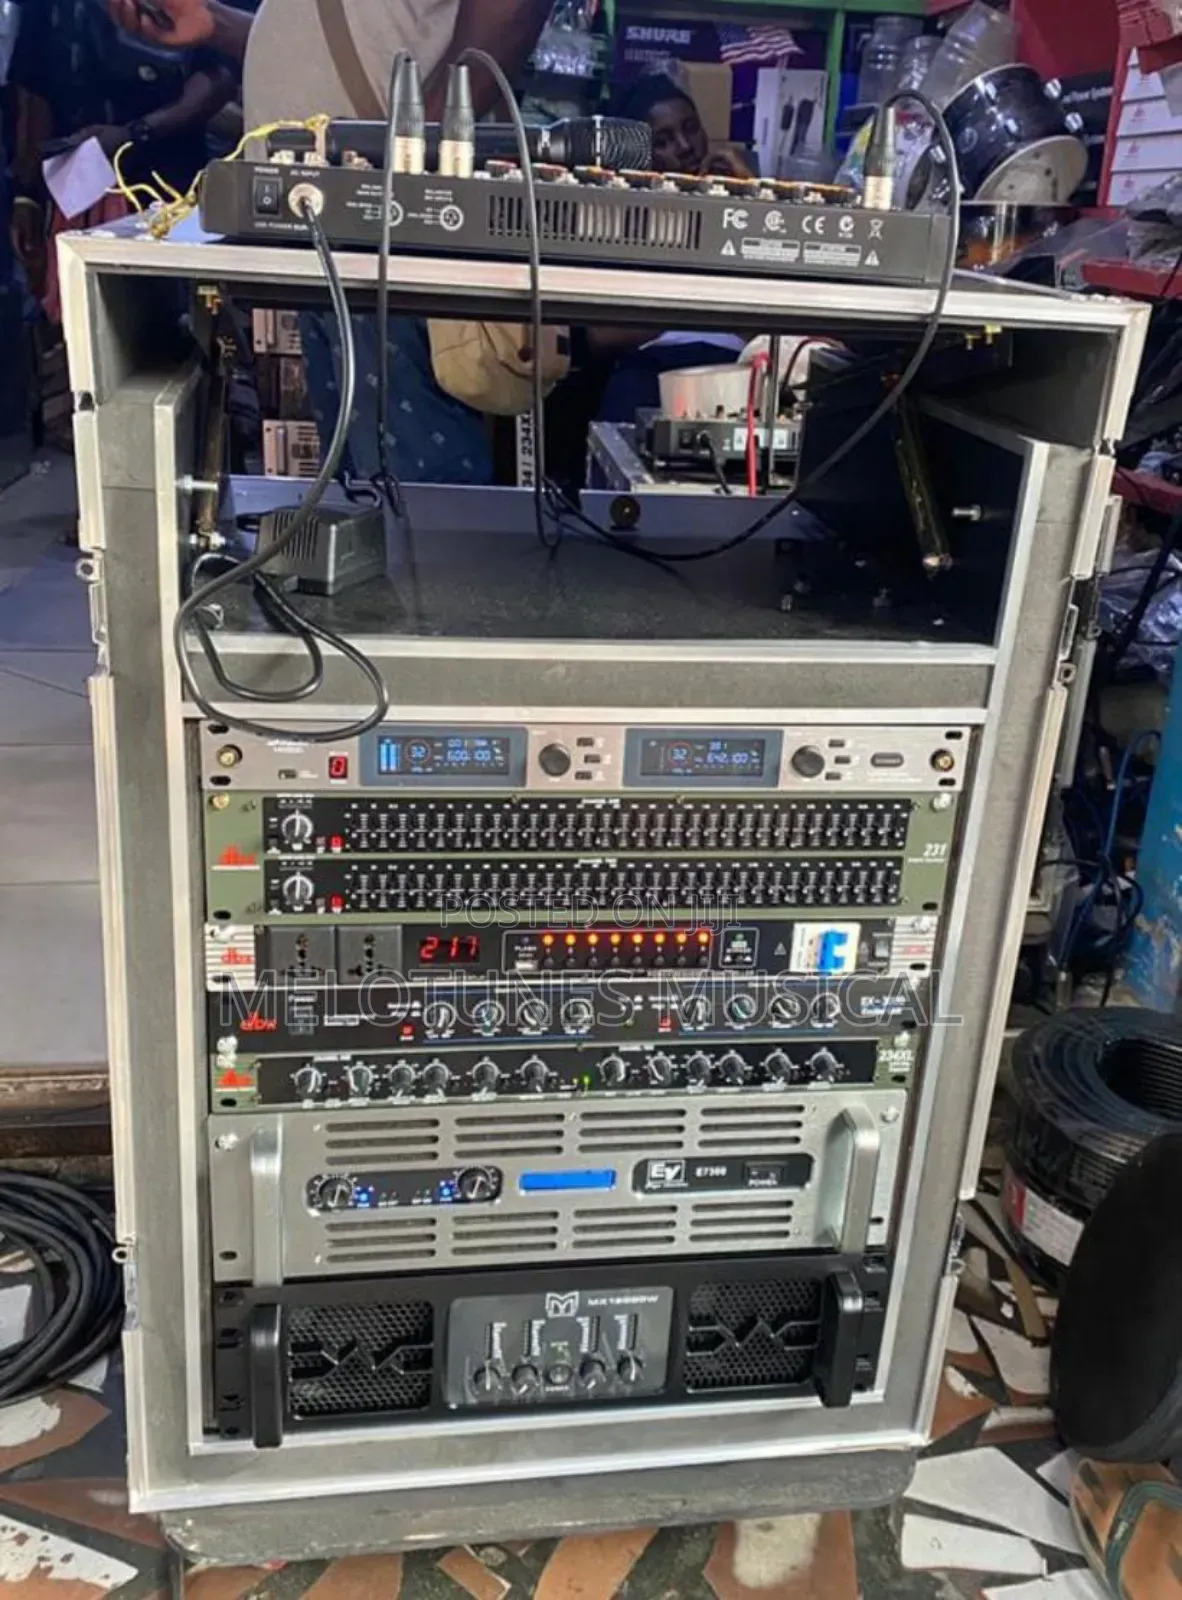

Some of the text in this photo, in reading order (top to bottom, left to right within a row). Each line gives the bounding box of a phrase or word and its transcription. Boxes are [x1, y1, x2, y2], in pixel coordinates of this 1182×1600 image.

[625, 25, 692, 45] SHURE
[922, 842, 947, 857] 231
[420, 936, 480, 959] 217
[240, 1010, 277, 1032] dbx
